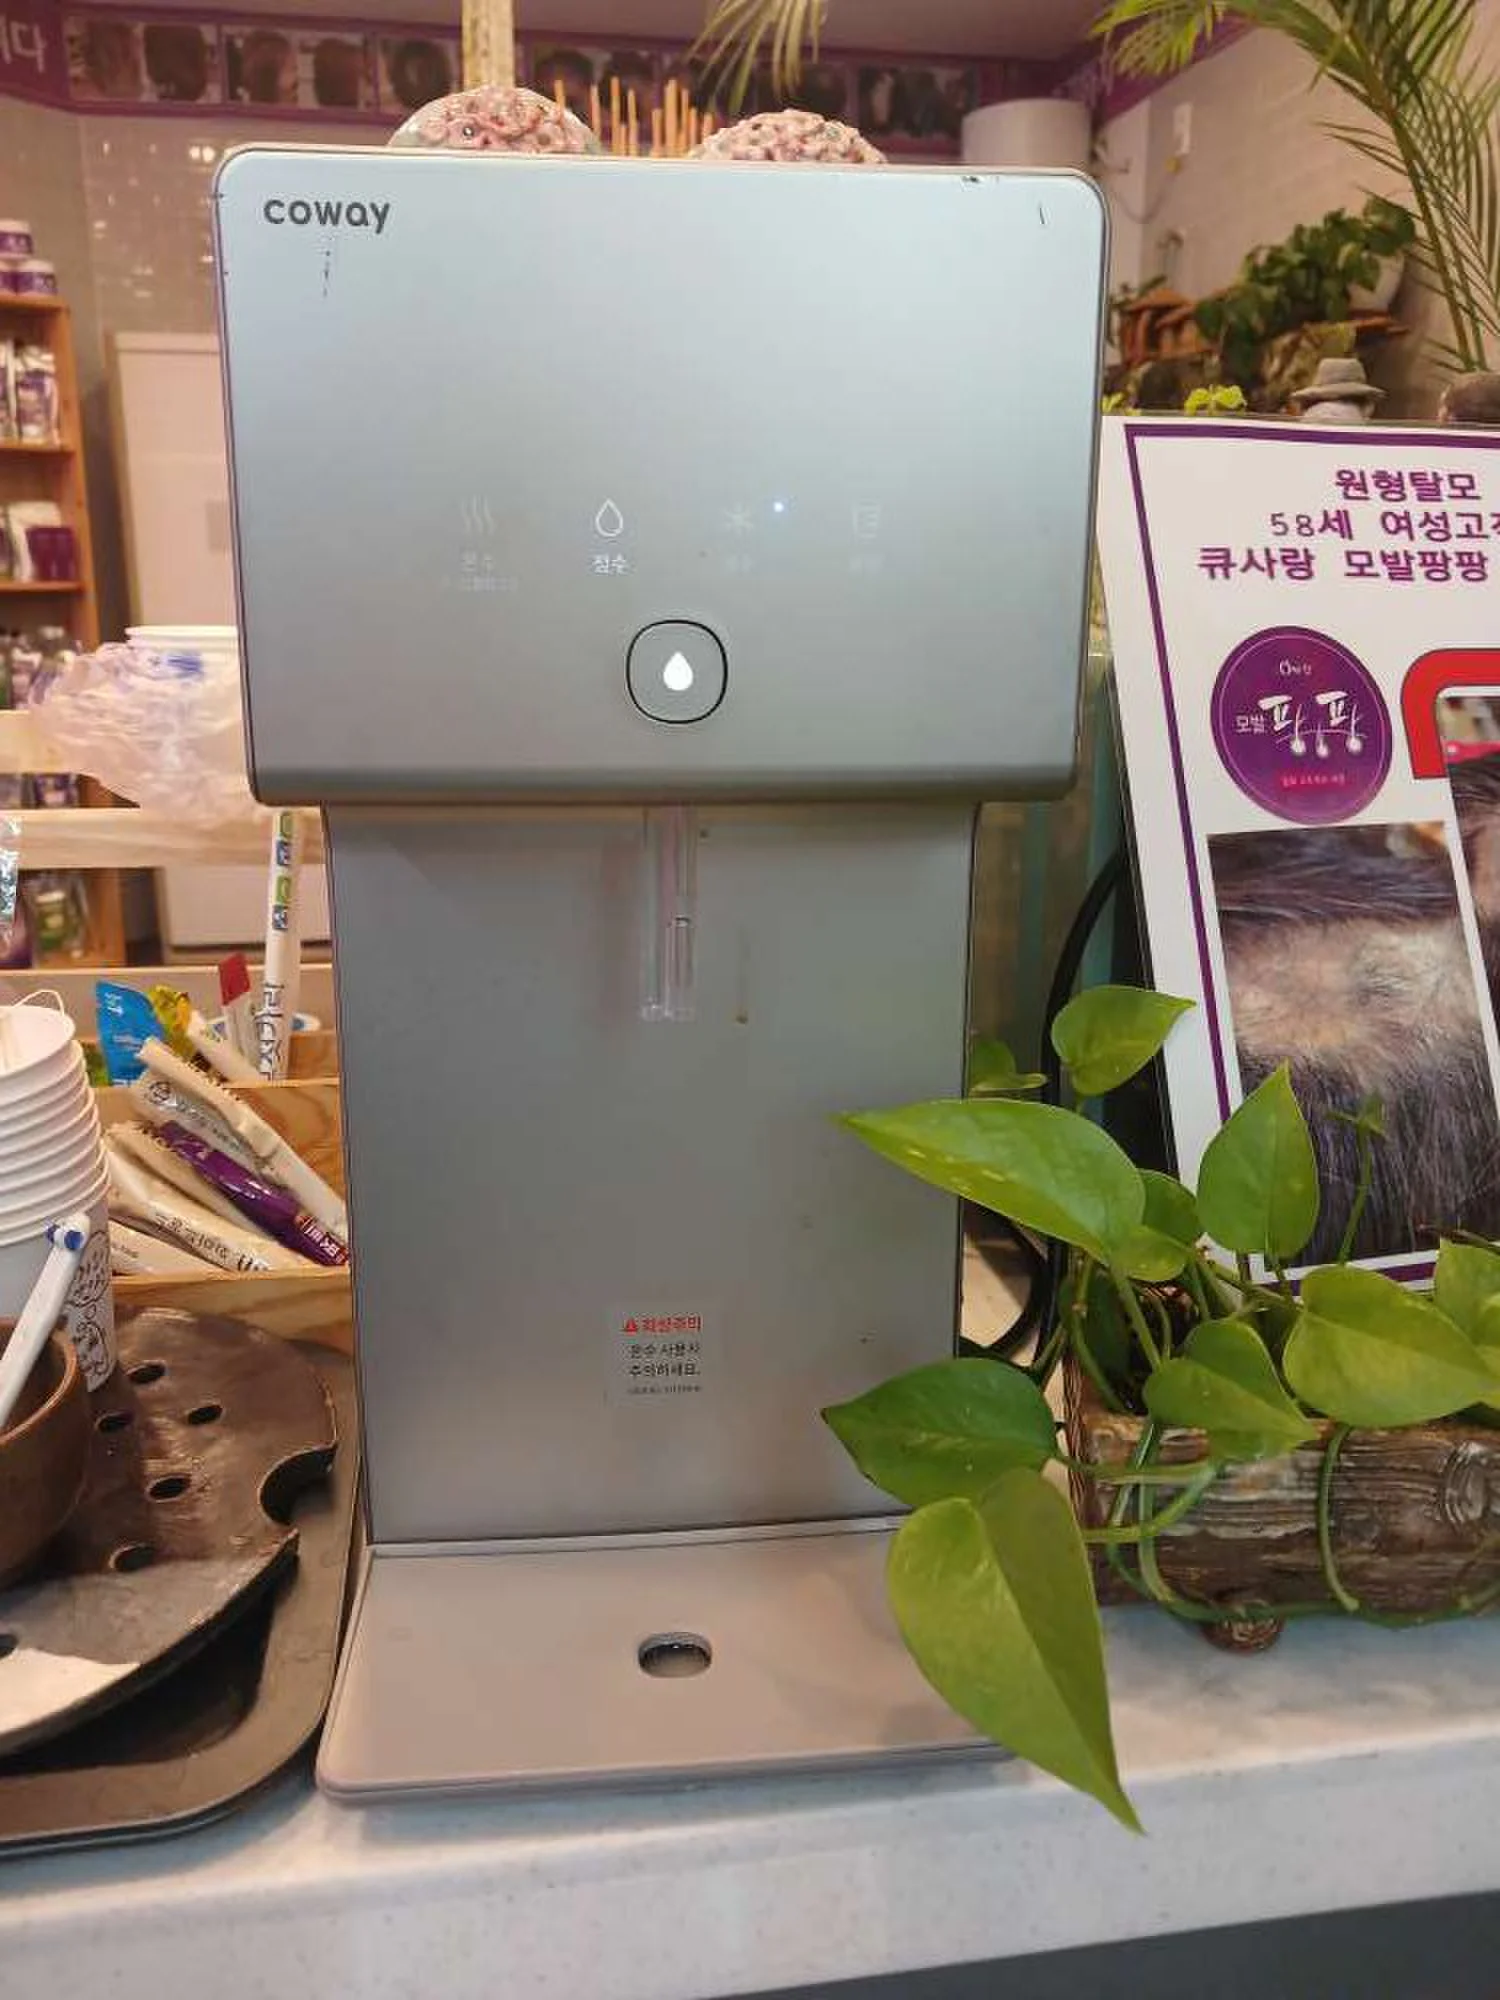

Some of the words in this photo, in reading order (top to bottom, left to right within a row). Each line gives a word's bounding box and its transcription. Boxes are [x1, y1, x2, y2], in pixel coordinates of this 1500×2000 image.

[263, 199, 390, 234] coway
[1335, 469, 1481, 502] 원형탈모
[1270, 510, 1353, 539] 58세
[1198, 547, 1315, 580] 큐사랑
[1344, 549, 1488, 582] 모발팡팡
